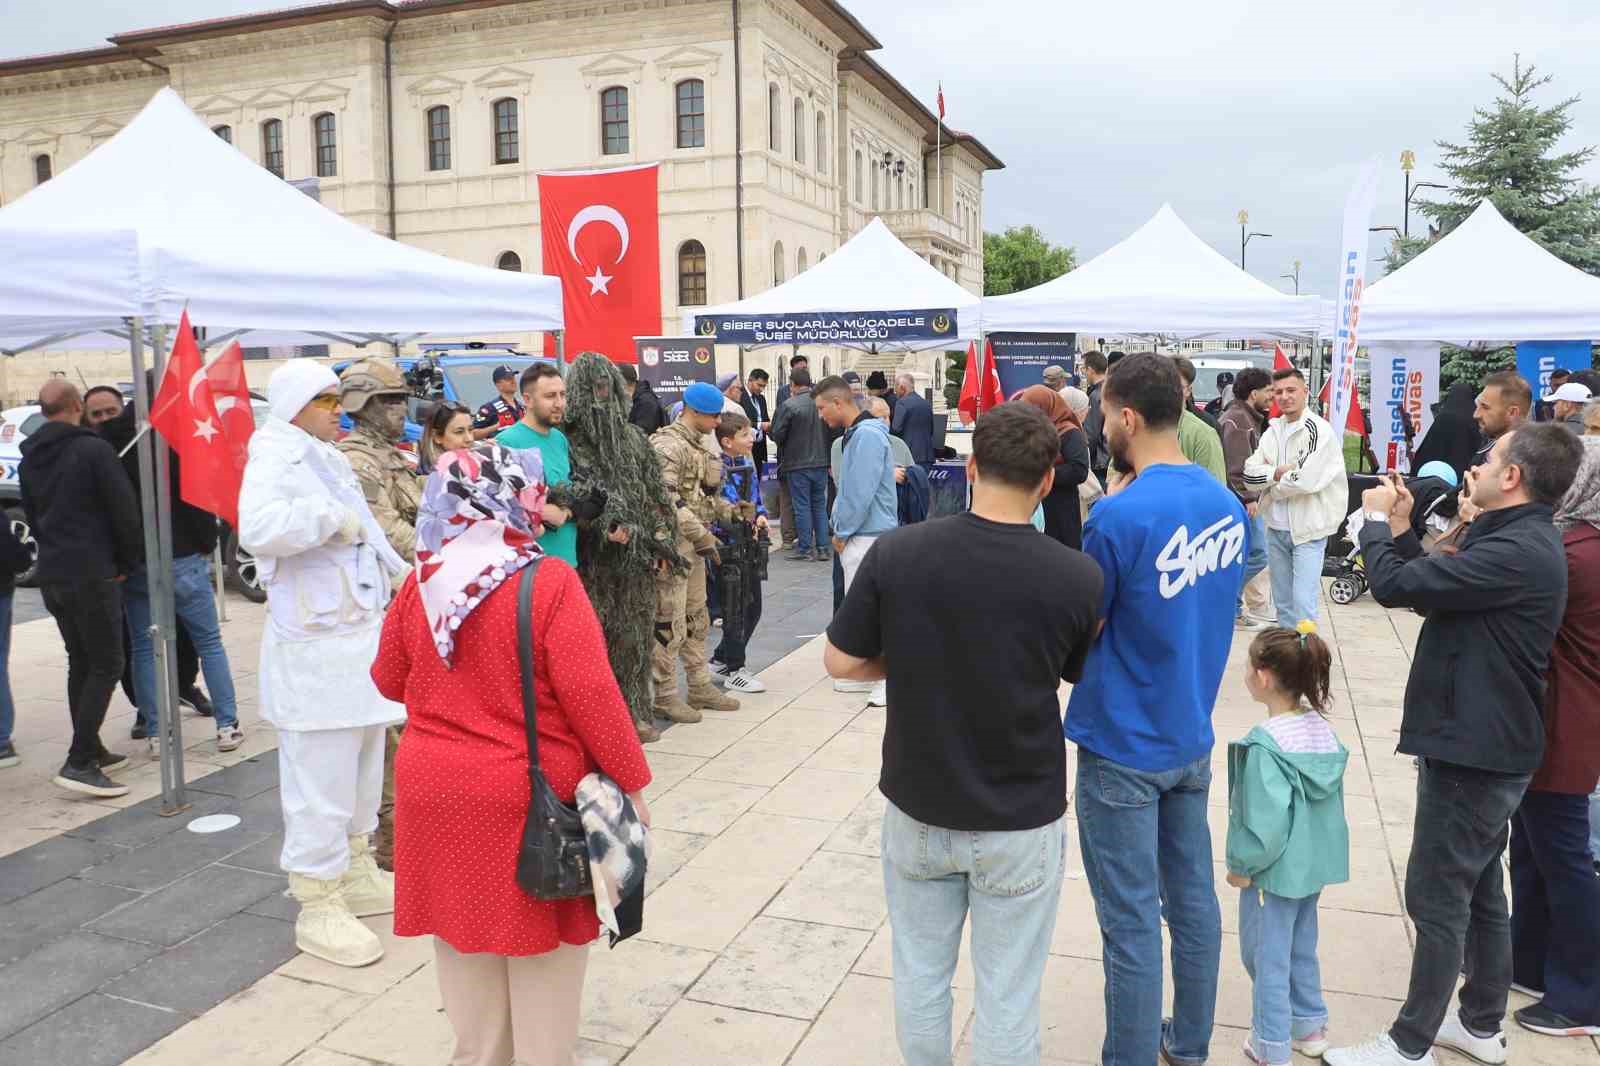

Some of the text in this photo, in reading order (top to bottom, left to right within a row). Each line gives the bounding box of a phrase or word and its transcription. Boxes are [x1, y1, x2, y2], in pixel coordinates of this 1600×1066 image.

[722, 317, 924, 331] SİBER SUÇLARLA MÜCADELE
[755, 328, 889, 341] ŞUBE MÜDÜRLÜĞÜ
[1409, 370, 1422, 433] sivas
